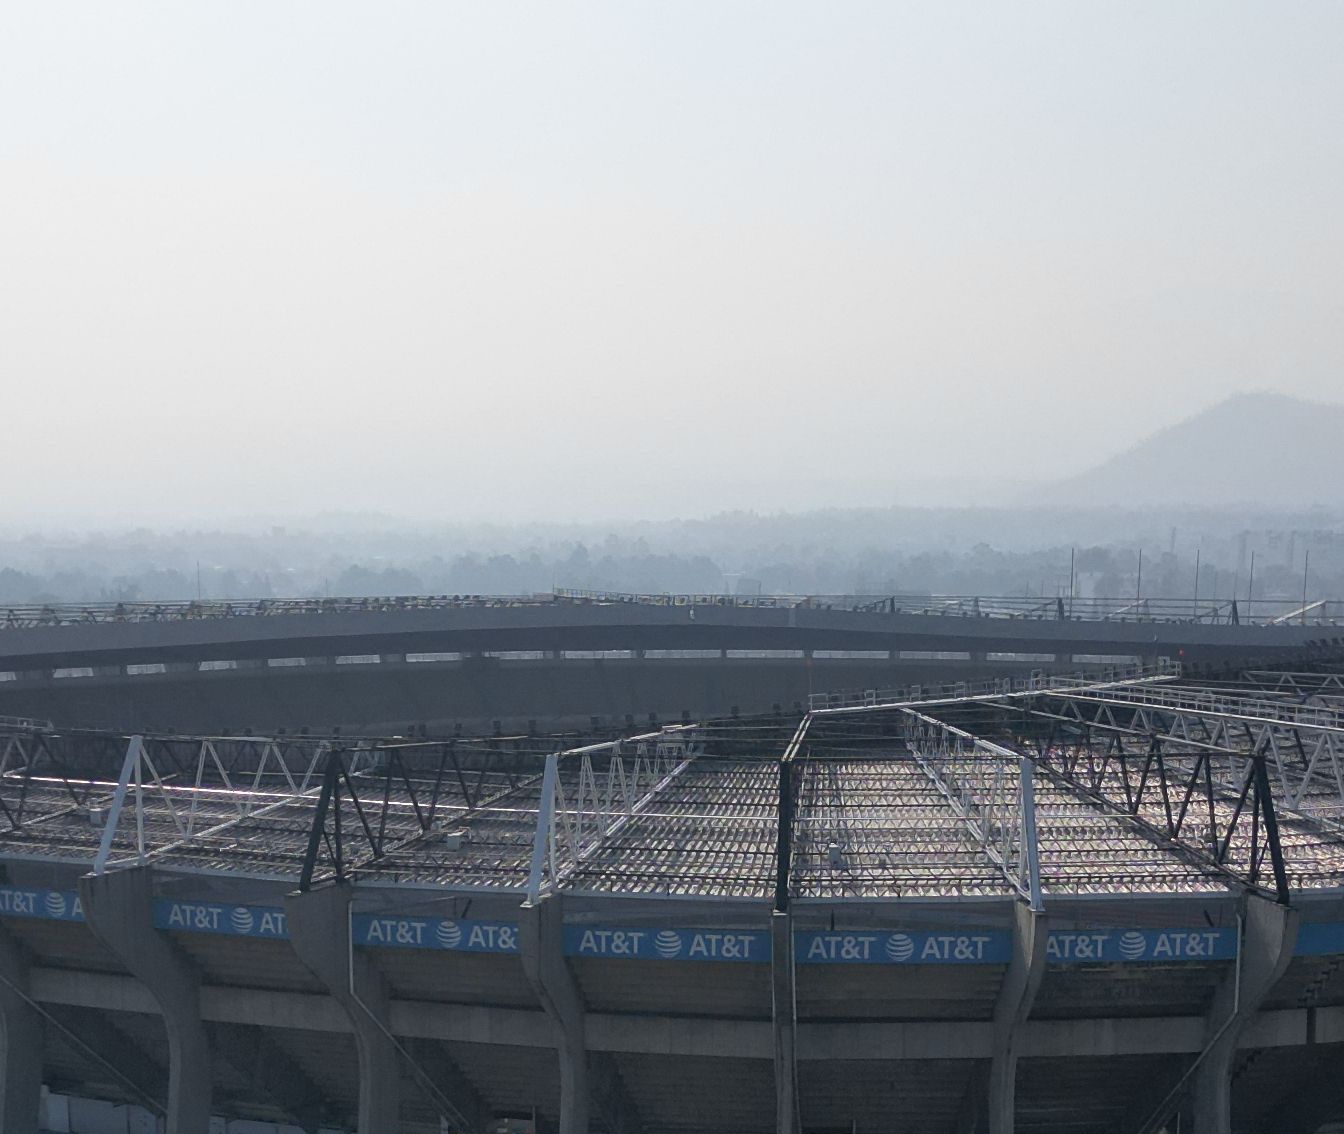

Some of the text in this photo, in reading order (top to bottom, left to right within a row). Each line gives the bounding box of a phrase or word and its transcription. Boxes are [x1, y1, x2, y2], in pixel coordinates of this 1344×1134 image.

[168, 904, 222, 929] AT&T
[367, 920, 427, 944] AT&T
[578, 930, 754, 958] AT&T AT&T
[806, 936, 990, 960] AT&T AT&T
[1045, 932, 1220, 958] AT&T AT&T
